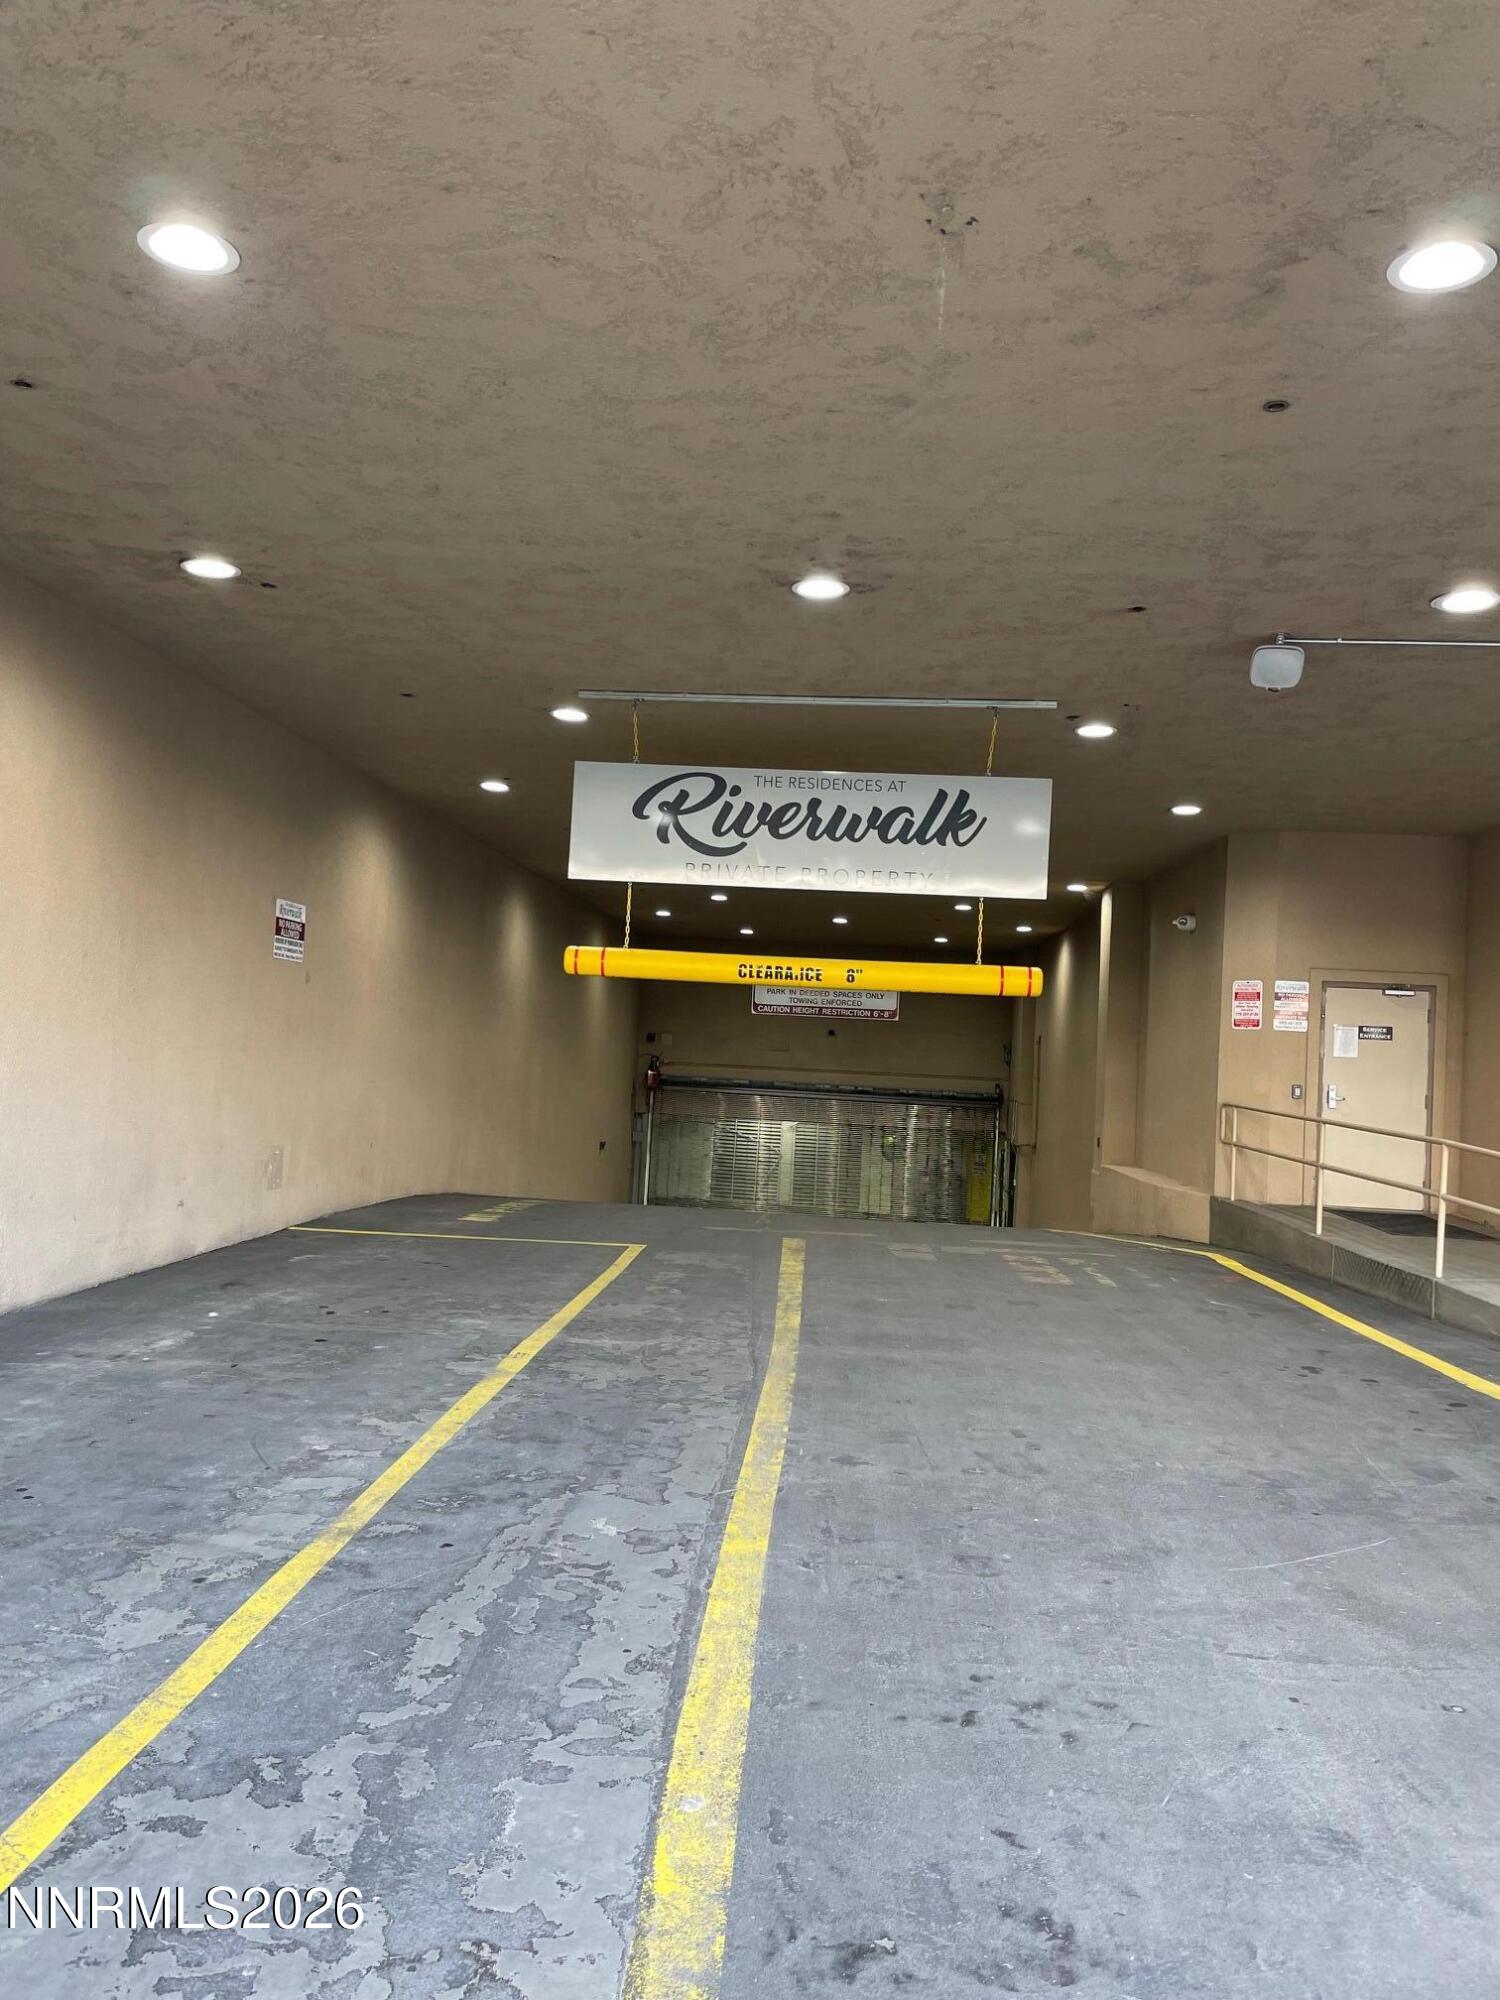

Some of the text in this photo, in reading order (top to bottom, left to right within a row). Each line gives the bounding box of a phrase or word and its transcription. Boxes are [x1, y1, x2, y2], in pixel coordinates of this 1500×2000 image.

[754, 775, 907, 793] THE RESIDENCES AT
[632, 772, 987, 857] Riverwalk
[685, 862, 934, 889] PRIVATE PROPERTY
[766, 988, 786, 996] PARK
[799, 990, 830, 998] DEEDED
[832, 991, 863, 999] SPACES
[865, 992, 885, 1000] ONLY
[789, 997, 863, 1007] TOWING ENFORCED
[758, 1004, 790, 1013] CAUTION
[792, 1006, 820, 1014] HEIGHT
[822, 1008, 871, 1017] RESTRICTION
